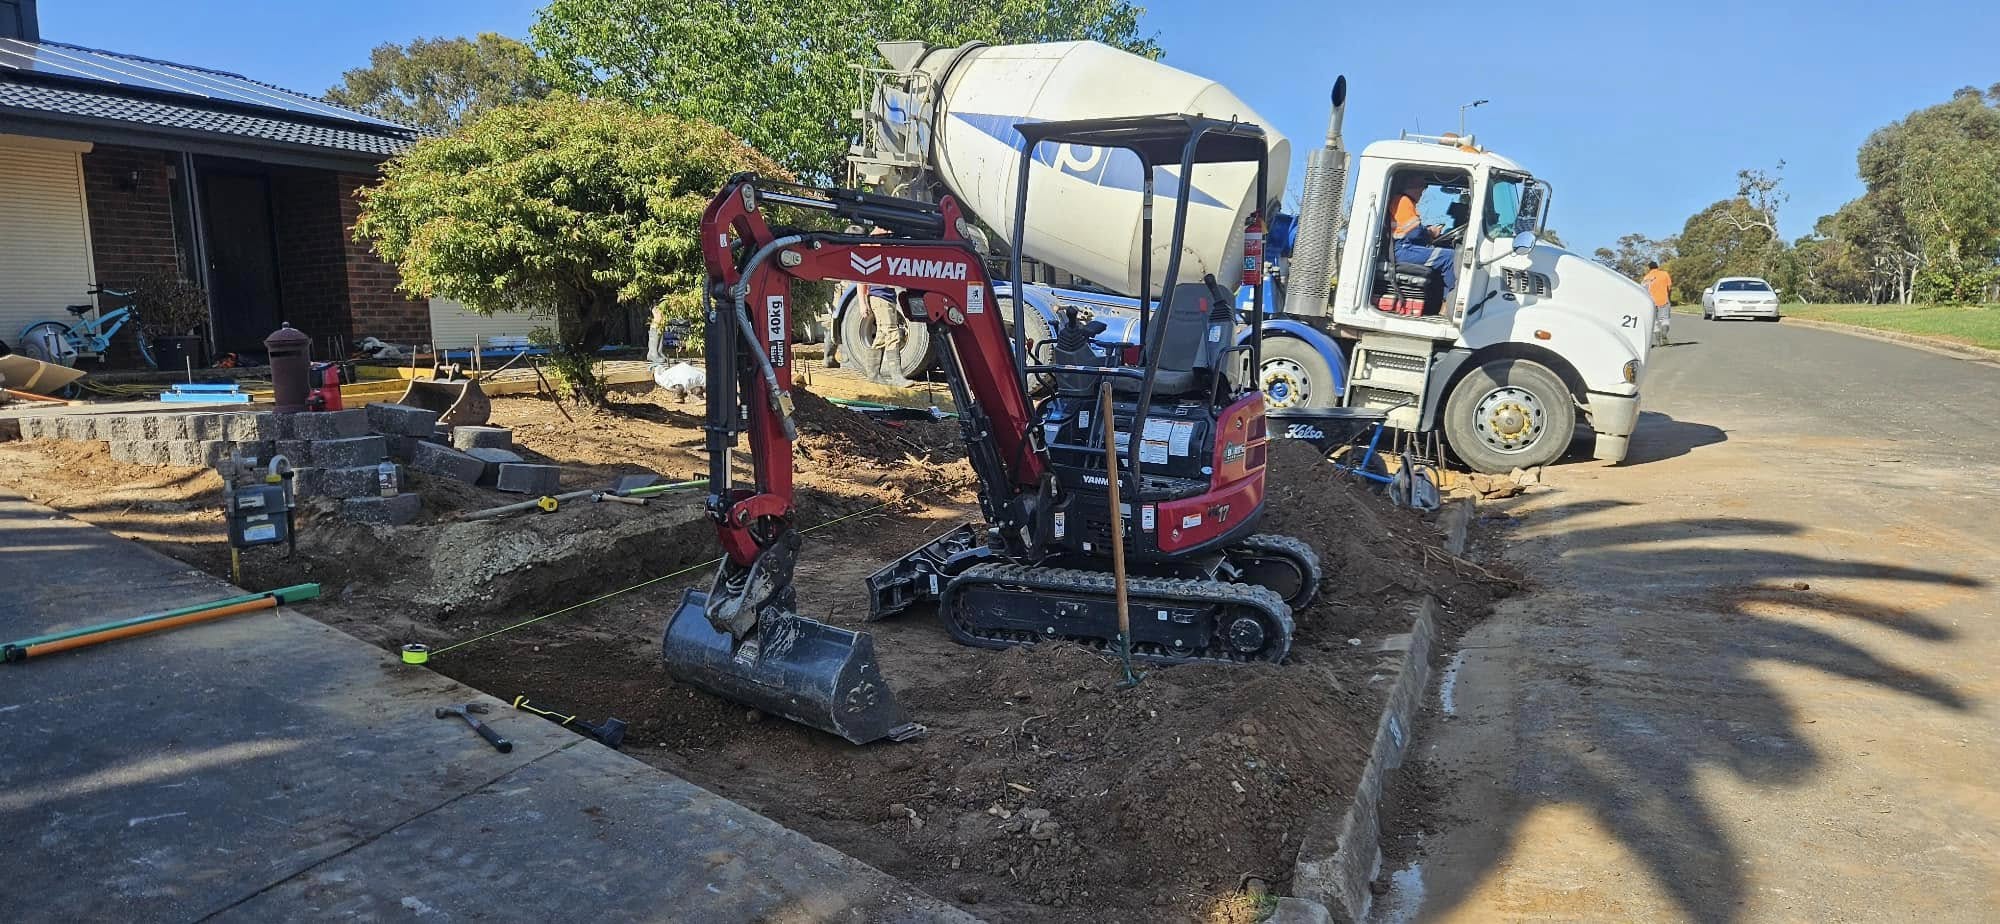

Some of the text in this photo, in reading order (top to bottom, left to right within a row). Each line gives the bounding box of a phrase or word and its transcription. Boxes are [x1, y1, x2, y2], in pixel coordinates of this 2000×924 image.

[887, 256, 967, 281] YANMAR
[770, 301, 783, 335] 40kg
[1621, 315, 1638, 329] 21
[1284, 424, 1325, 439] Kelso
[1083, 475, 1123, 488] YANMR
